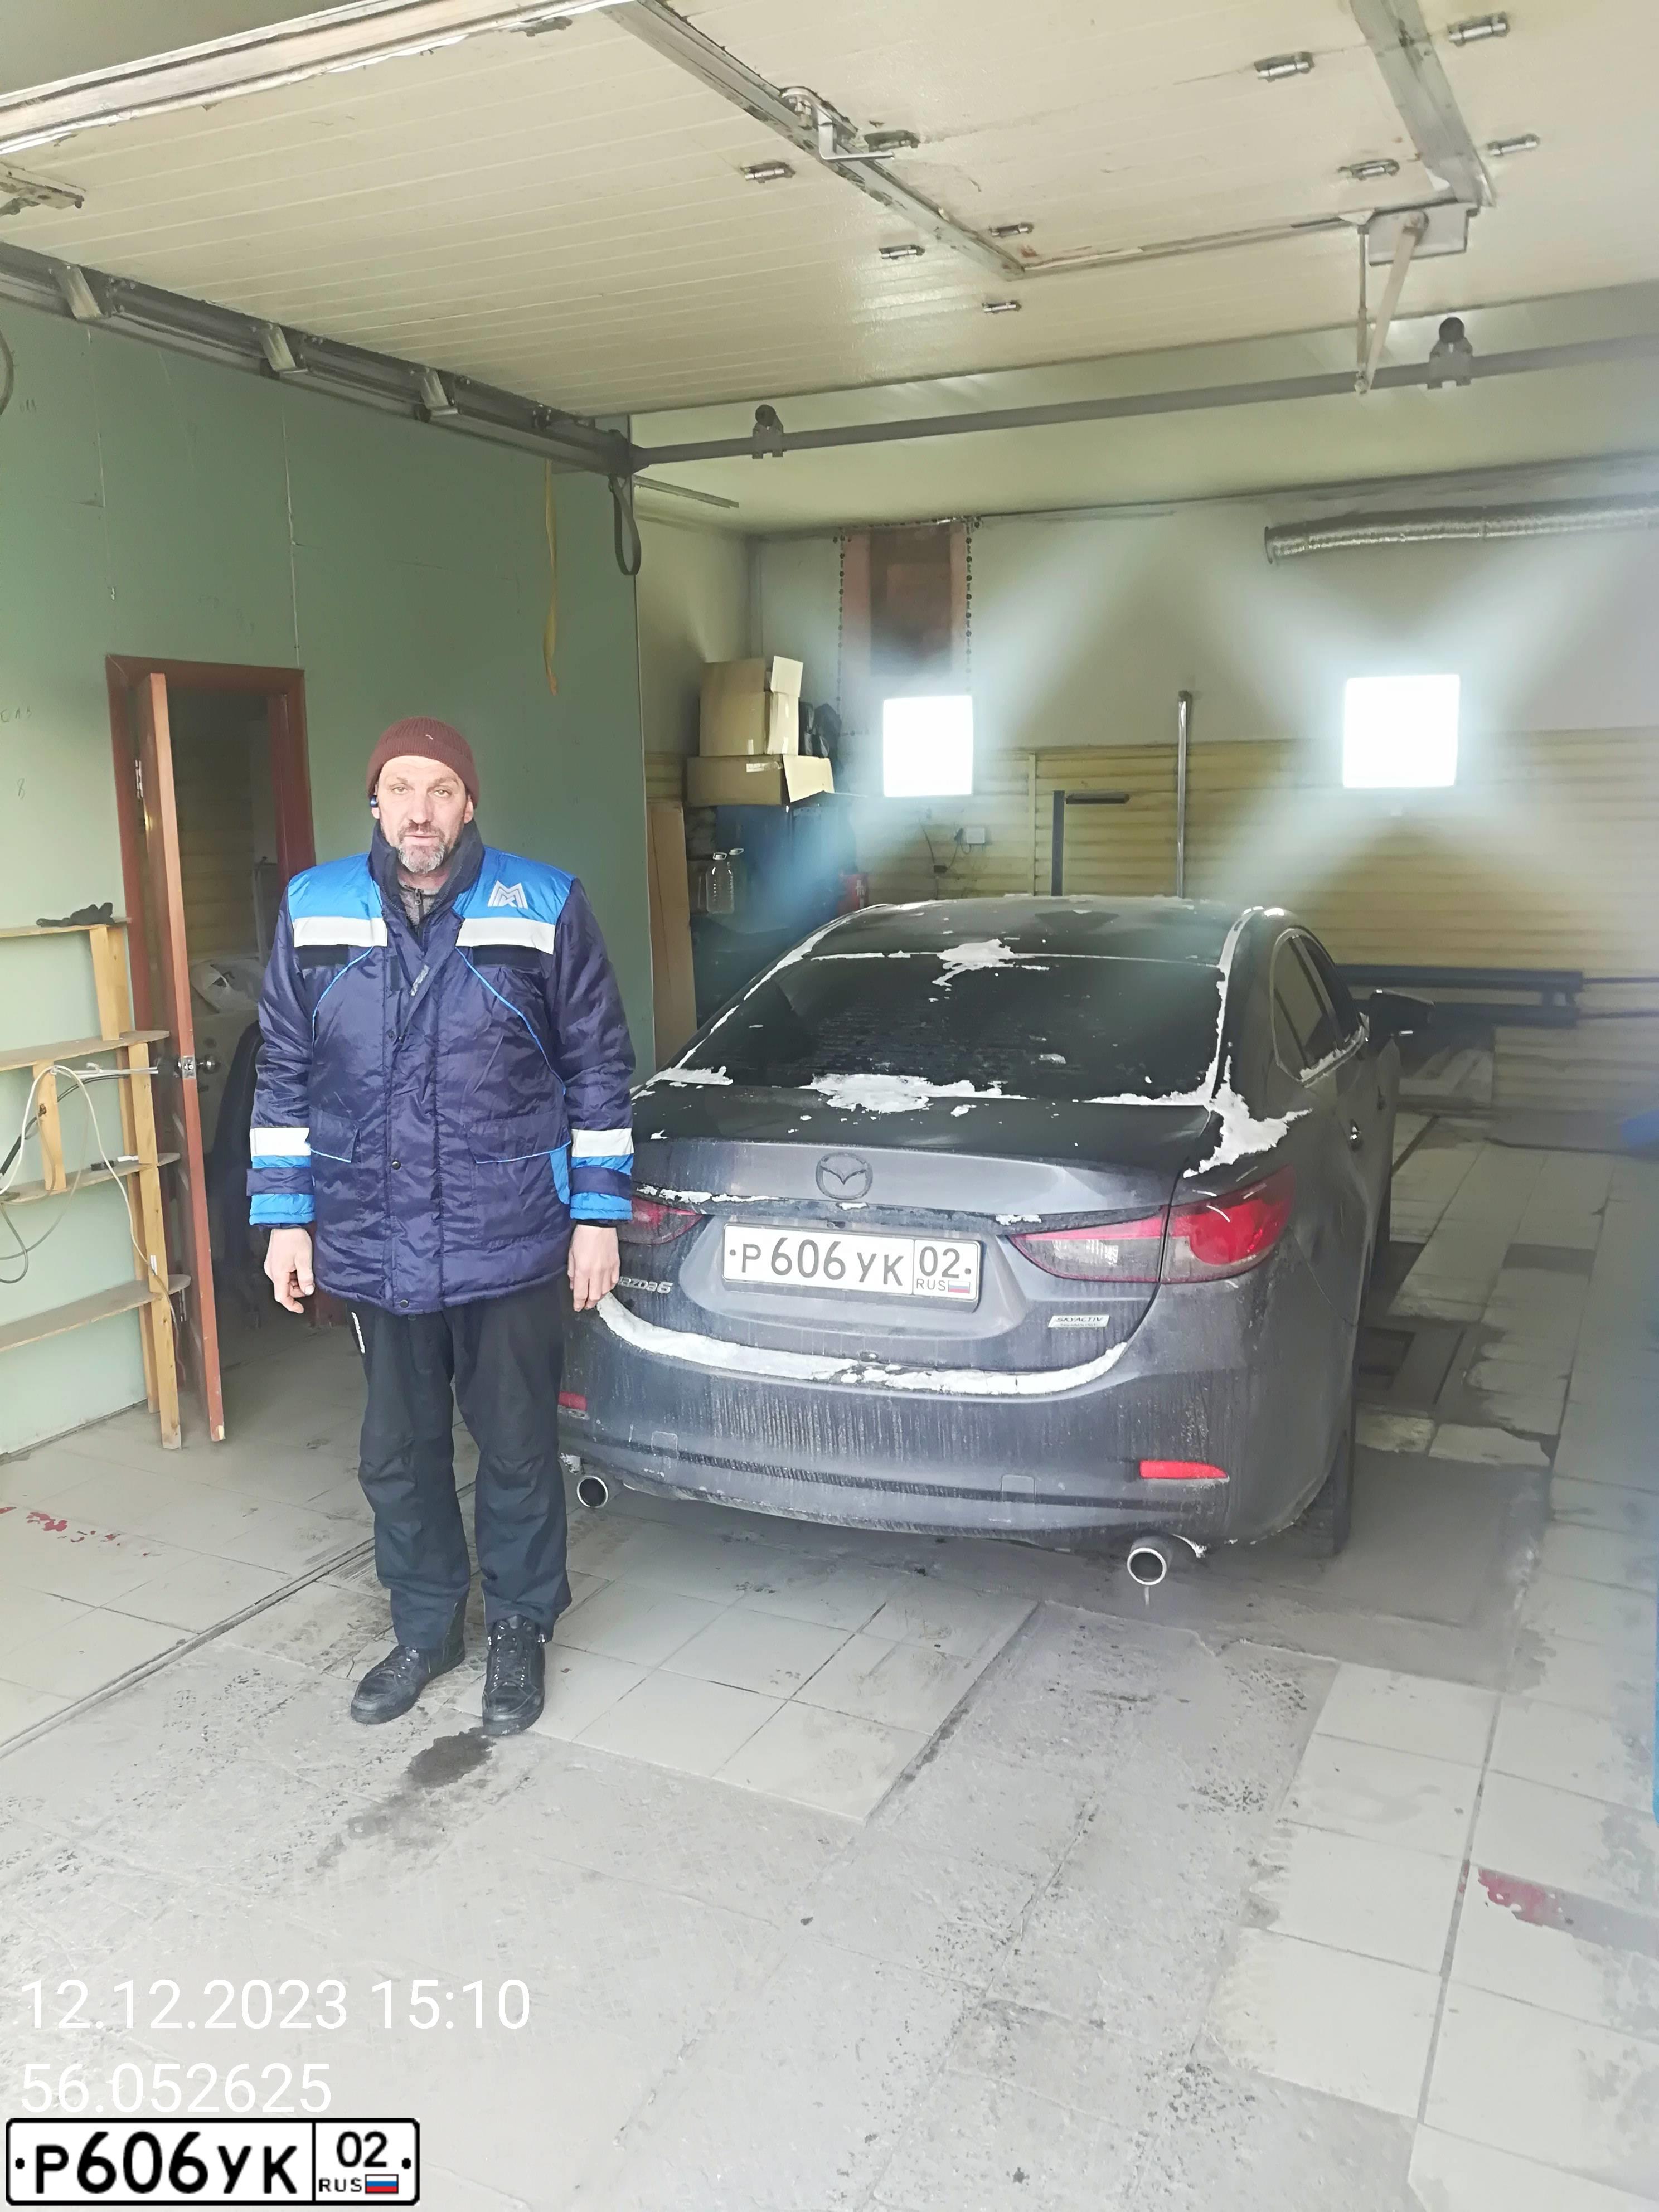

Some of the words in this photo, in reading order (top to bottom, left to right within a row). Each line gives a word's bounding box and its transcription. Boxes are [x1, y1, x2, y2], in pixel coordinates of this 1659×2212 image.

[741, 1236, 904, 1287] Р606УК
[919, 1246, 960, 1279] 02
[916, 1278, 947, 1291] RUS
